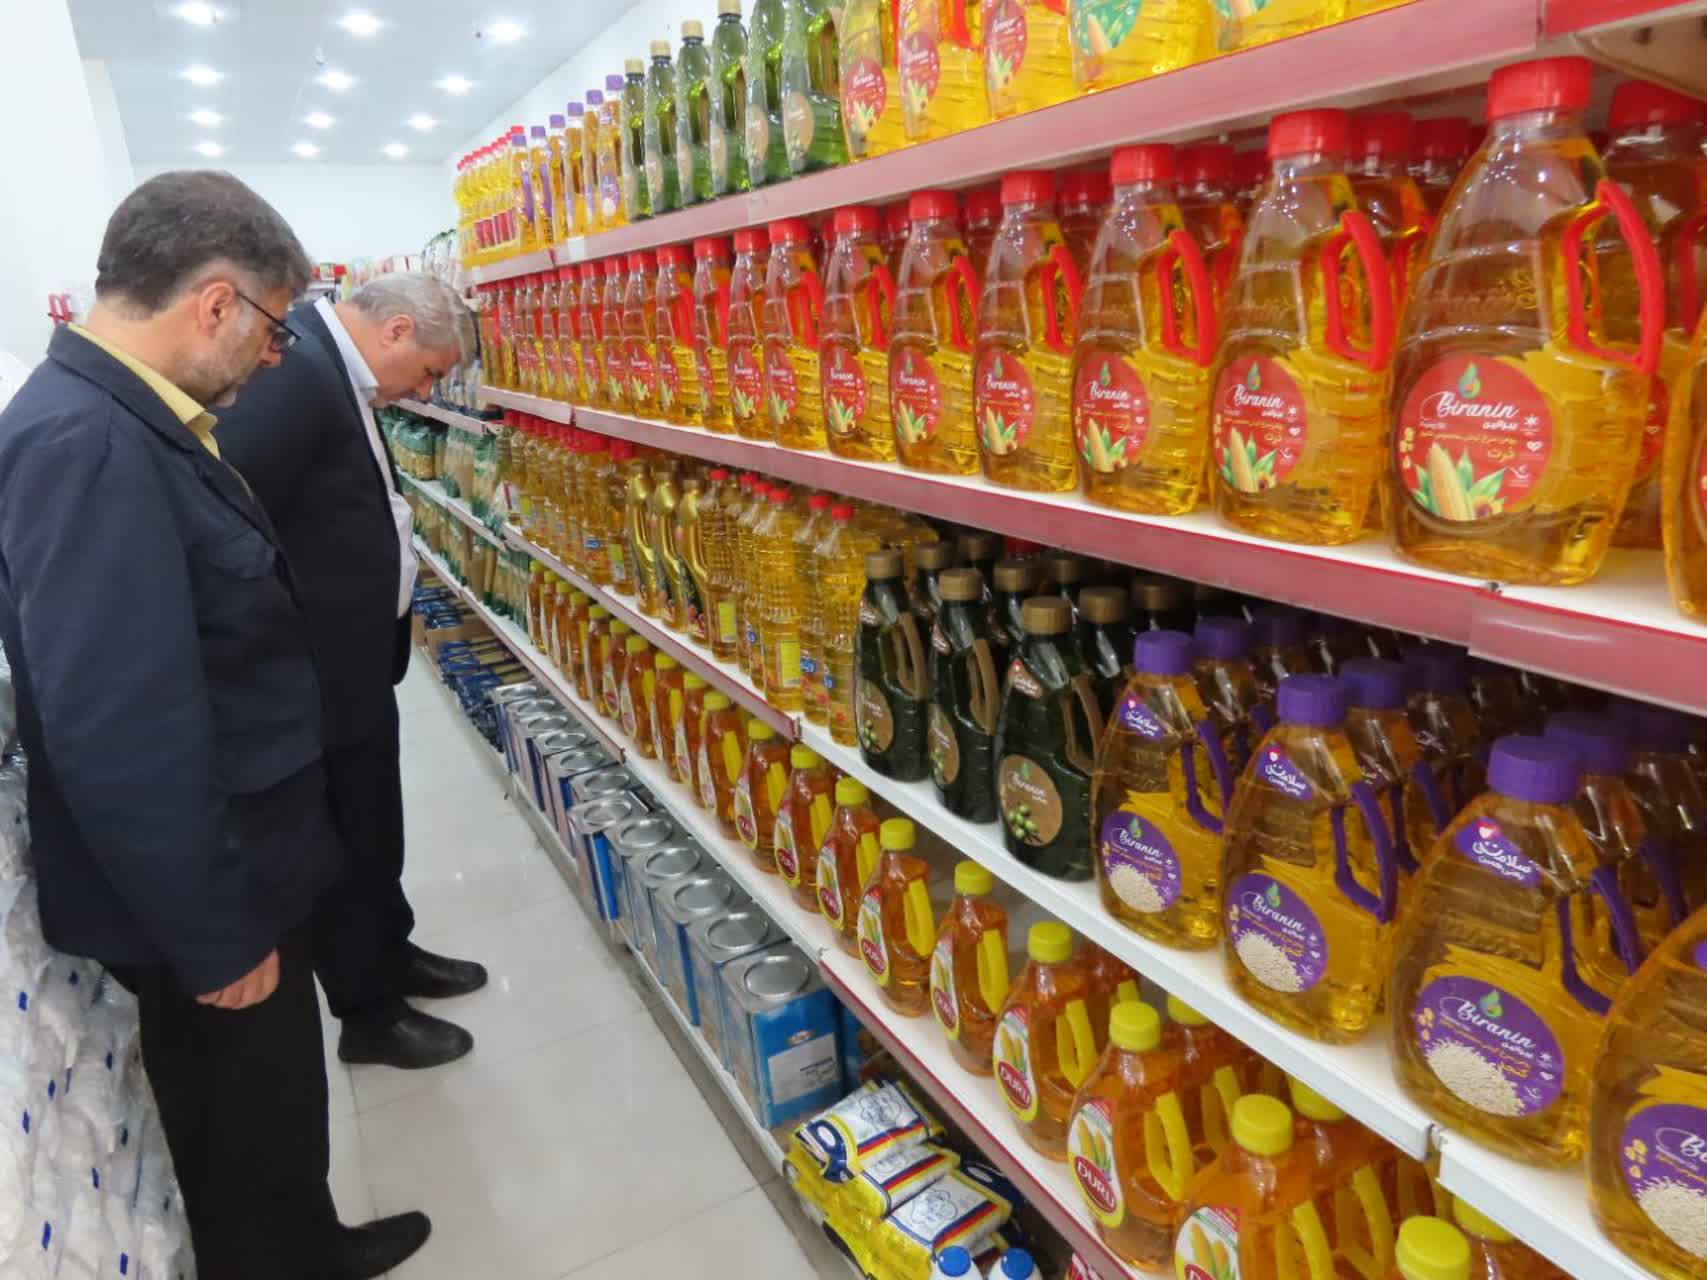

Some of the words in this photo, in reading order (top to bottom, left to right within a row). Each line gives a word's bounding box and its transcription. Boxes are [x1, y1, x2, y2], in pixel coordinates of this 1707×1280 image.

[1232, 384, 1286, 408] Biranin
[1428, 391, 1519, 418] Biranin
[1472, 841, 1533, 874] سلامتی
[1249, 892, 1305, 931] Biranin
[1451, 998, 1537, 1049] Biranin
[1077, 1160, 1116, 1208] DURU
